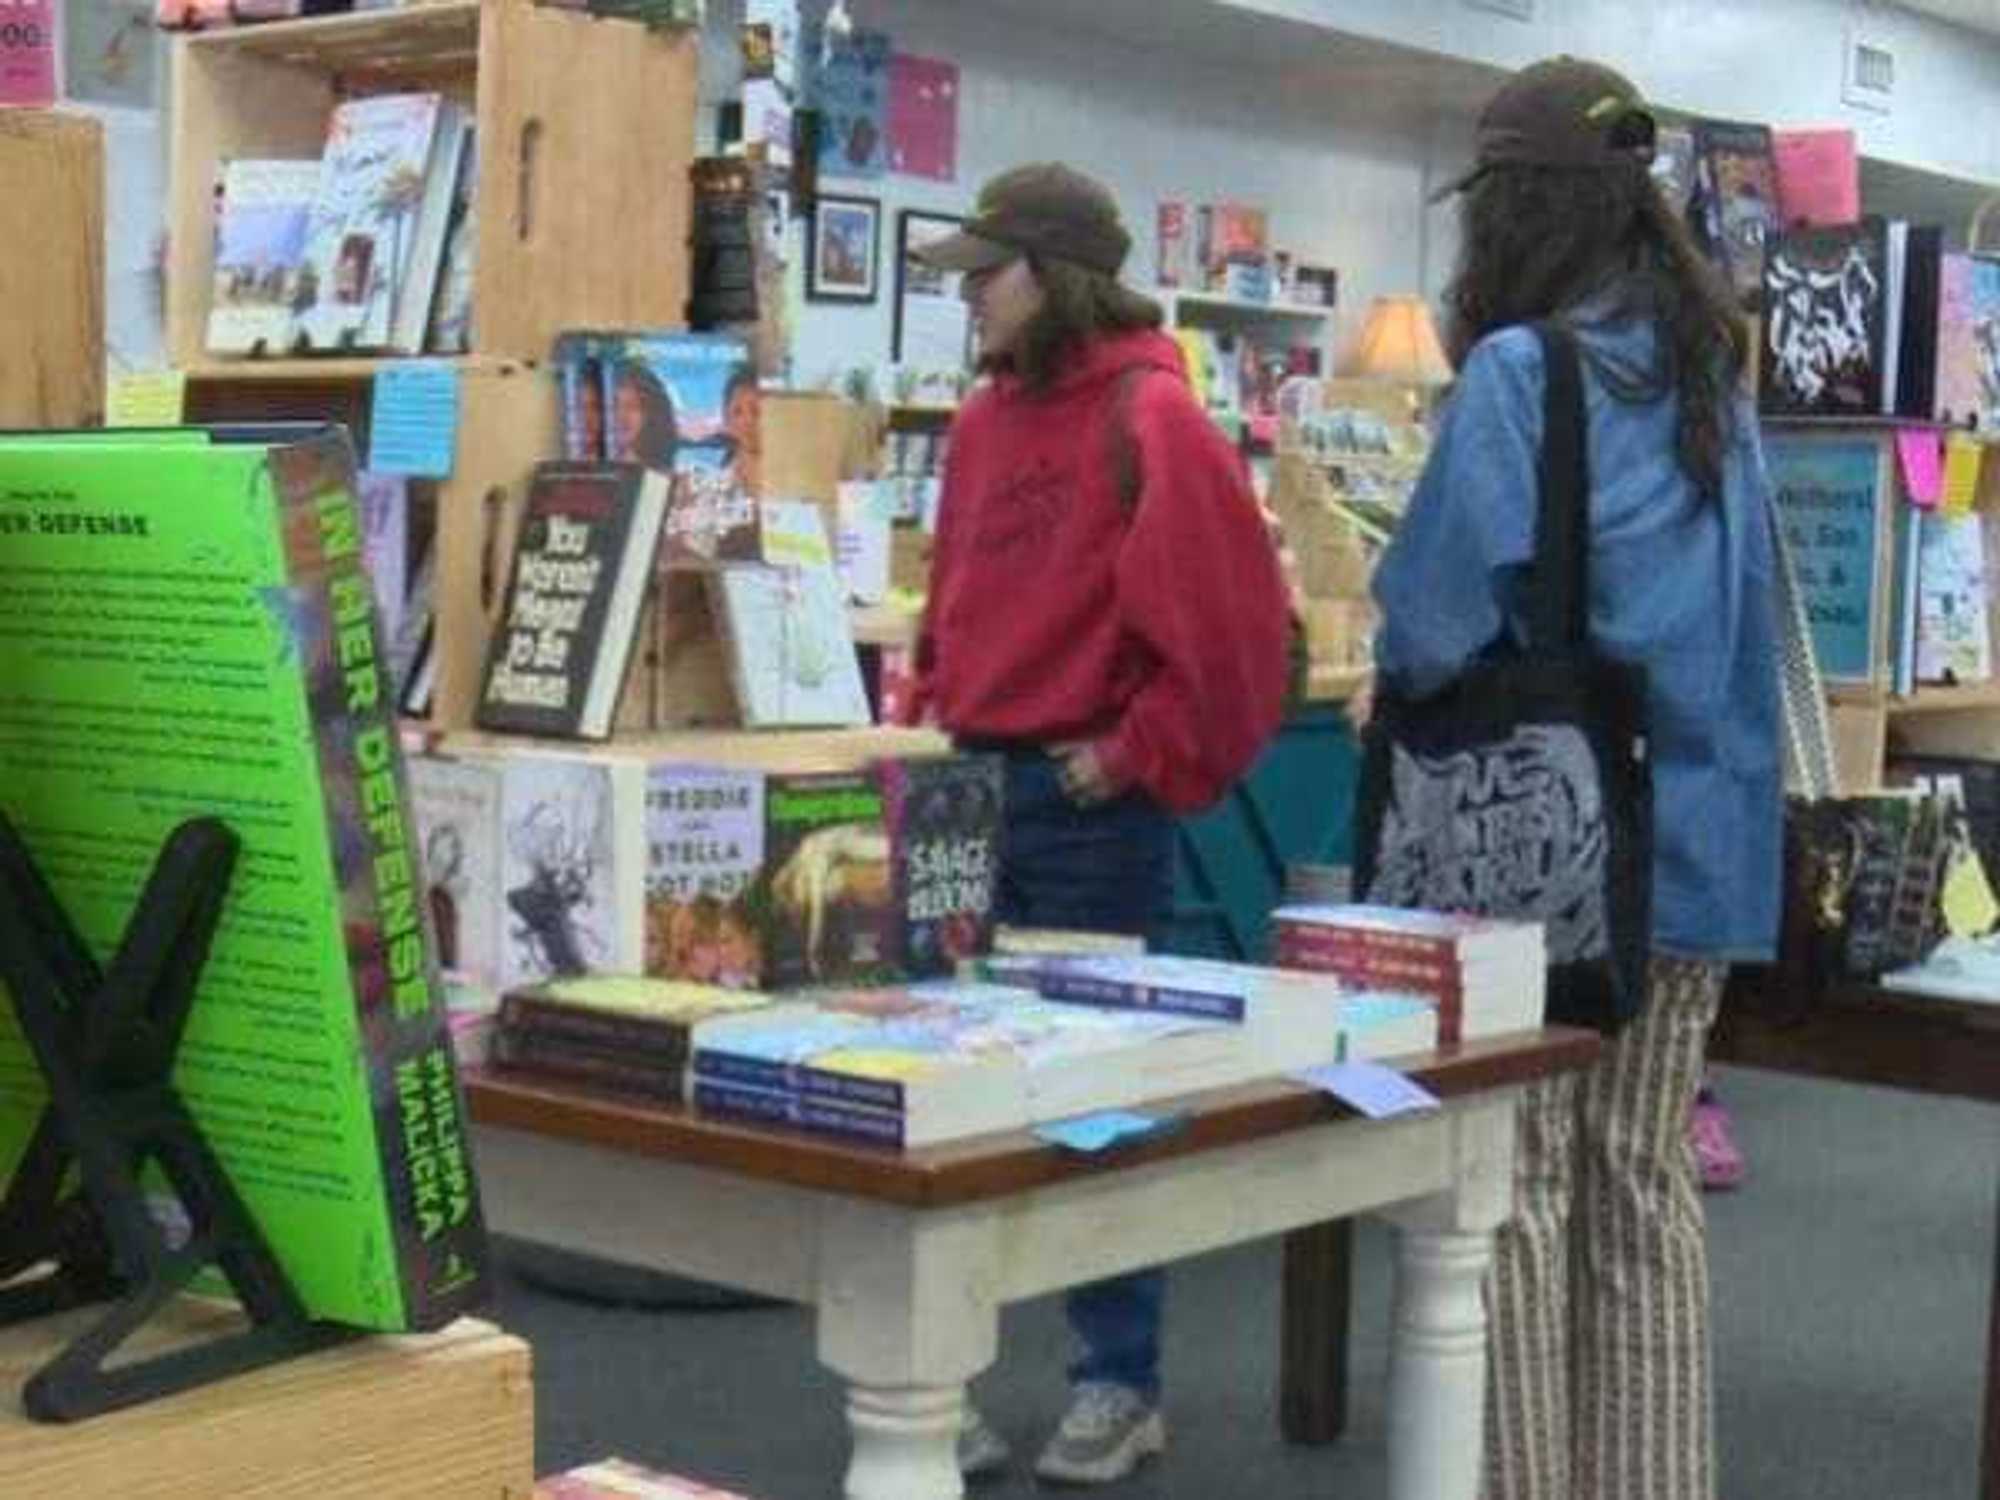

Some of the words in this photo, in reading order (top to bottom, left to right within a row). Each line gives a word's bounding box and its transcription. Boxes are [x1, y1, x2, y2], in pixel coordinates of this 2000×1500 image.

[317, 479, 360, 560] IN
[331, 577, 379, 714] HER
[643, 785, 750, 812] FREDDIE
[650, 840, 742, 868] STELLA
[355, 727, 430, 1020] DEFENSE
[395, 1057, 445, 1244] MALICKA
[425, 1047, 473, 1227] PHILIPPA
